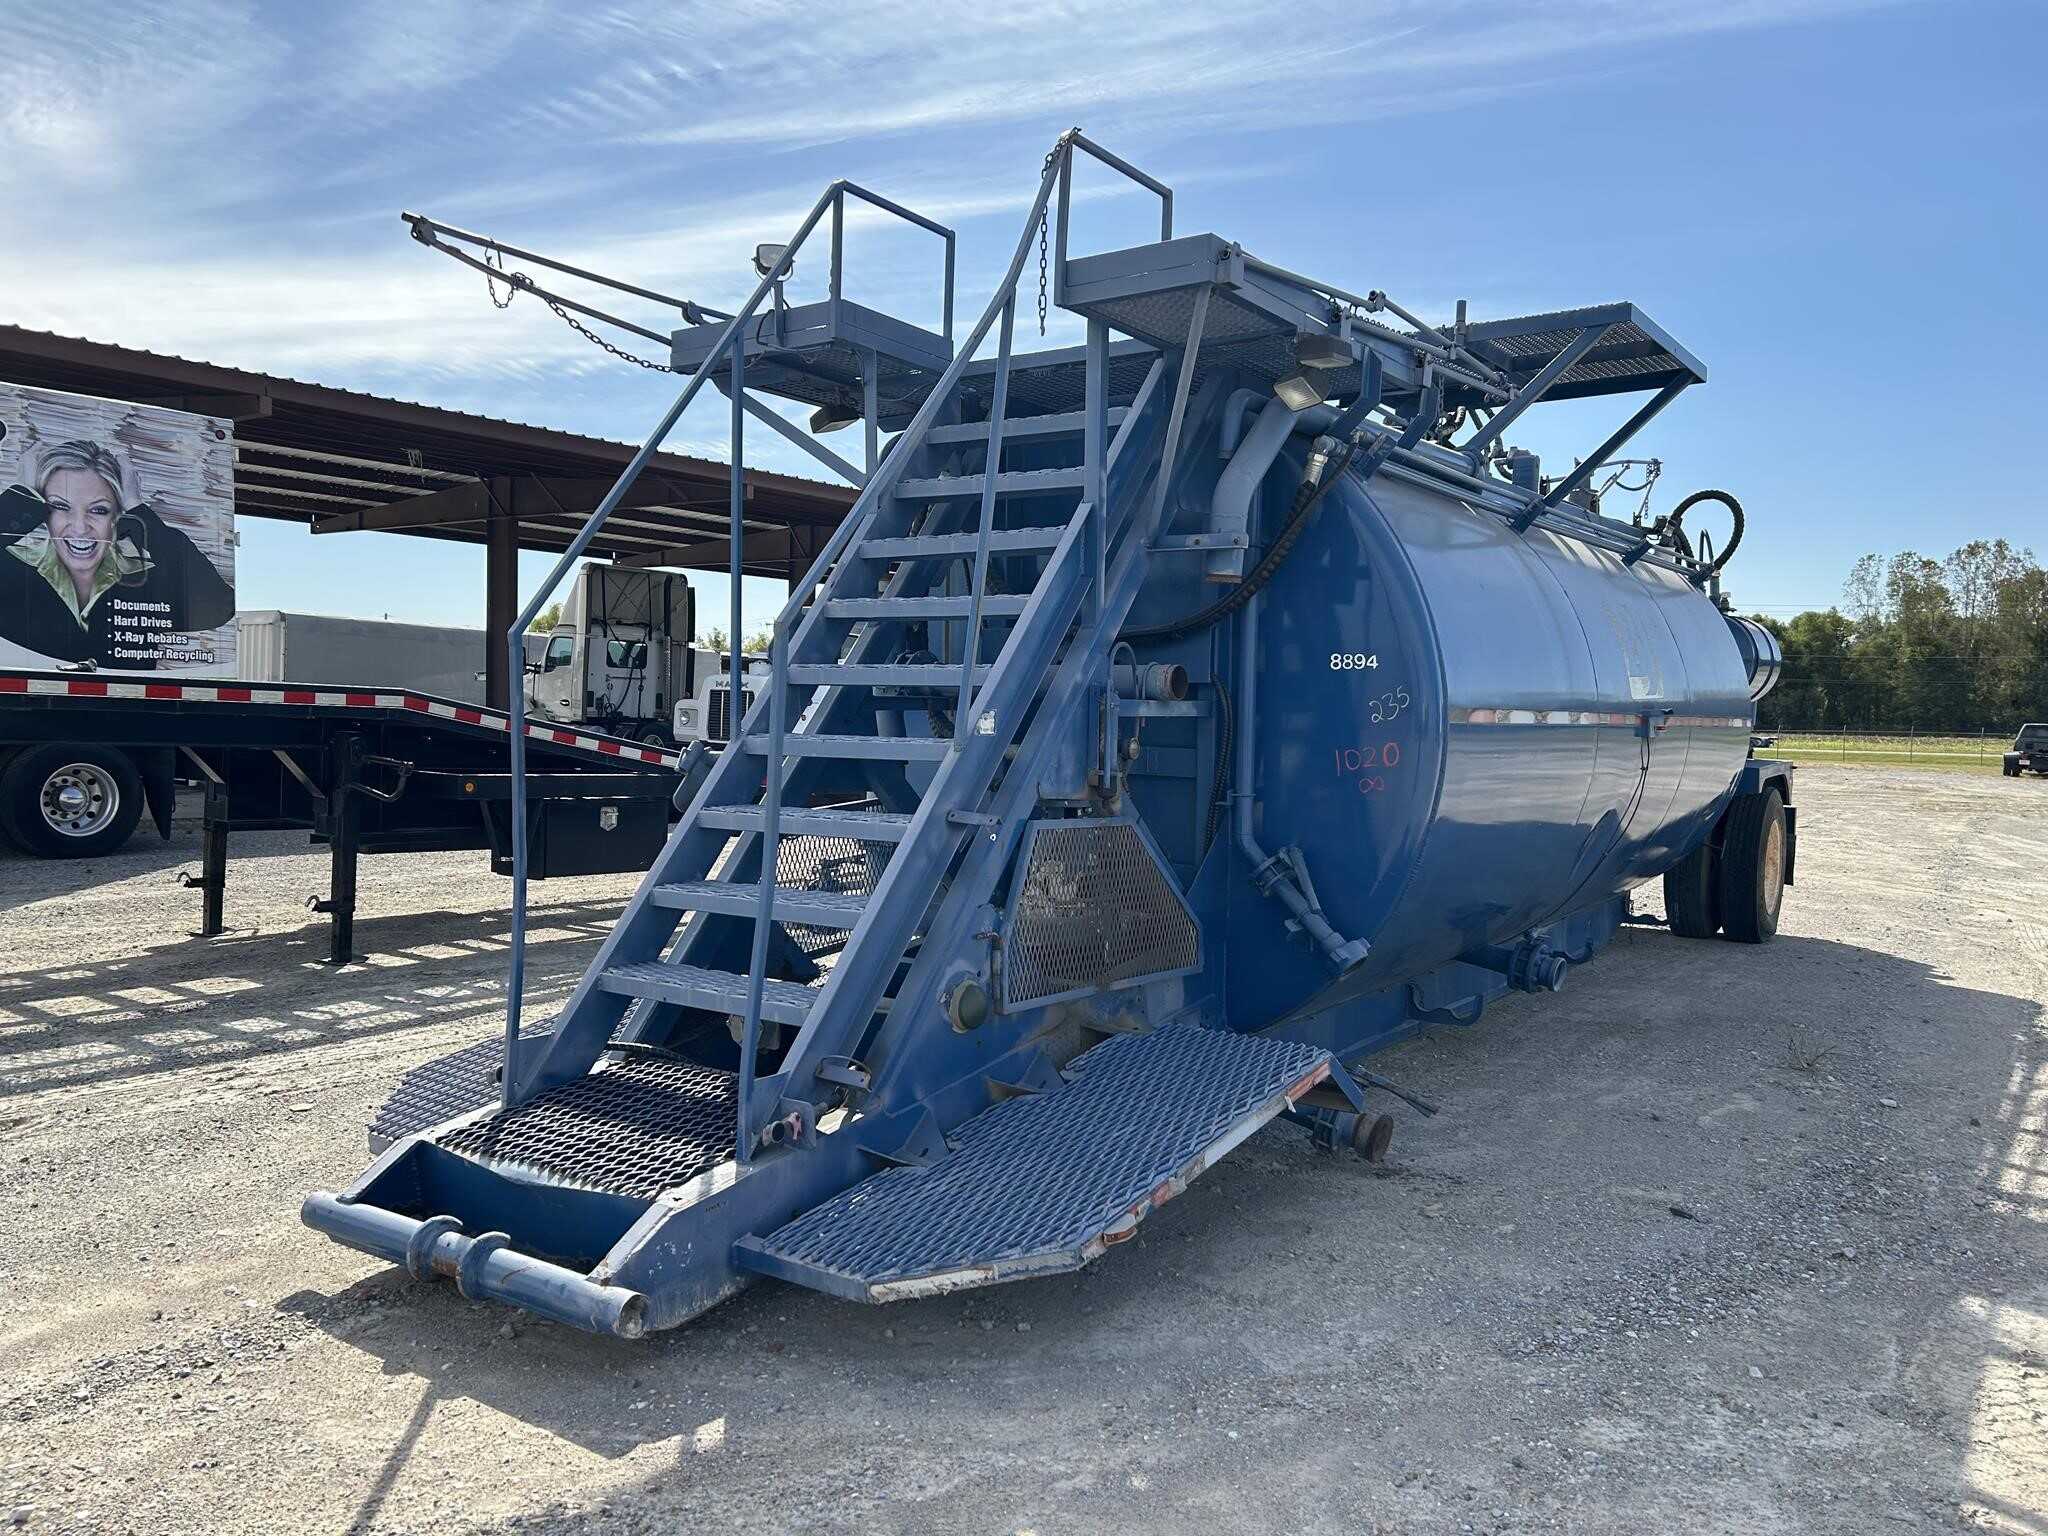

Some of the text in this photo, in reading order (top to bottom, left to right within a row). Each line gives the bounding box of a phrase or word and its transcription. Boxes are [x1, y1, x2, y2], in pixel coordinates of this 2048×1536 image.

[114, 599, 170, 612] Documents
[114, 615, 172, 628] Hard Drives
[114, 631, 188, 644] X-Ray Rebates
[114, 647, 214, 662] Computer Recycling
[1330, 653, 1378, 670] 8894
[1369, 686, 1410, 723] 235
[1335, 742, 1400, 776] 1020
